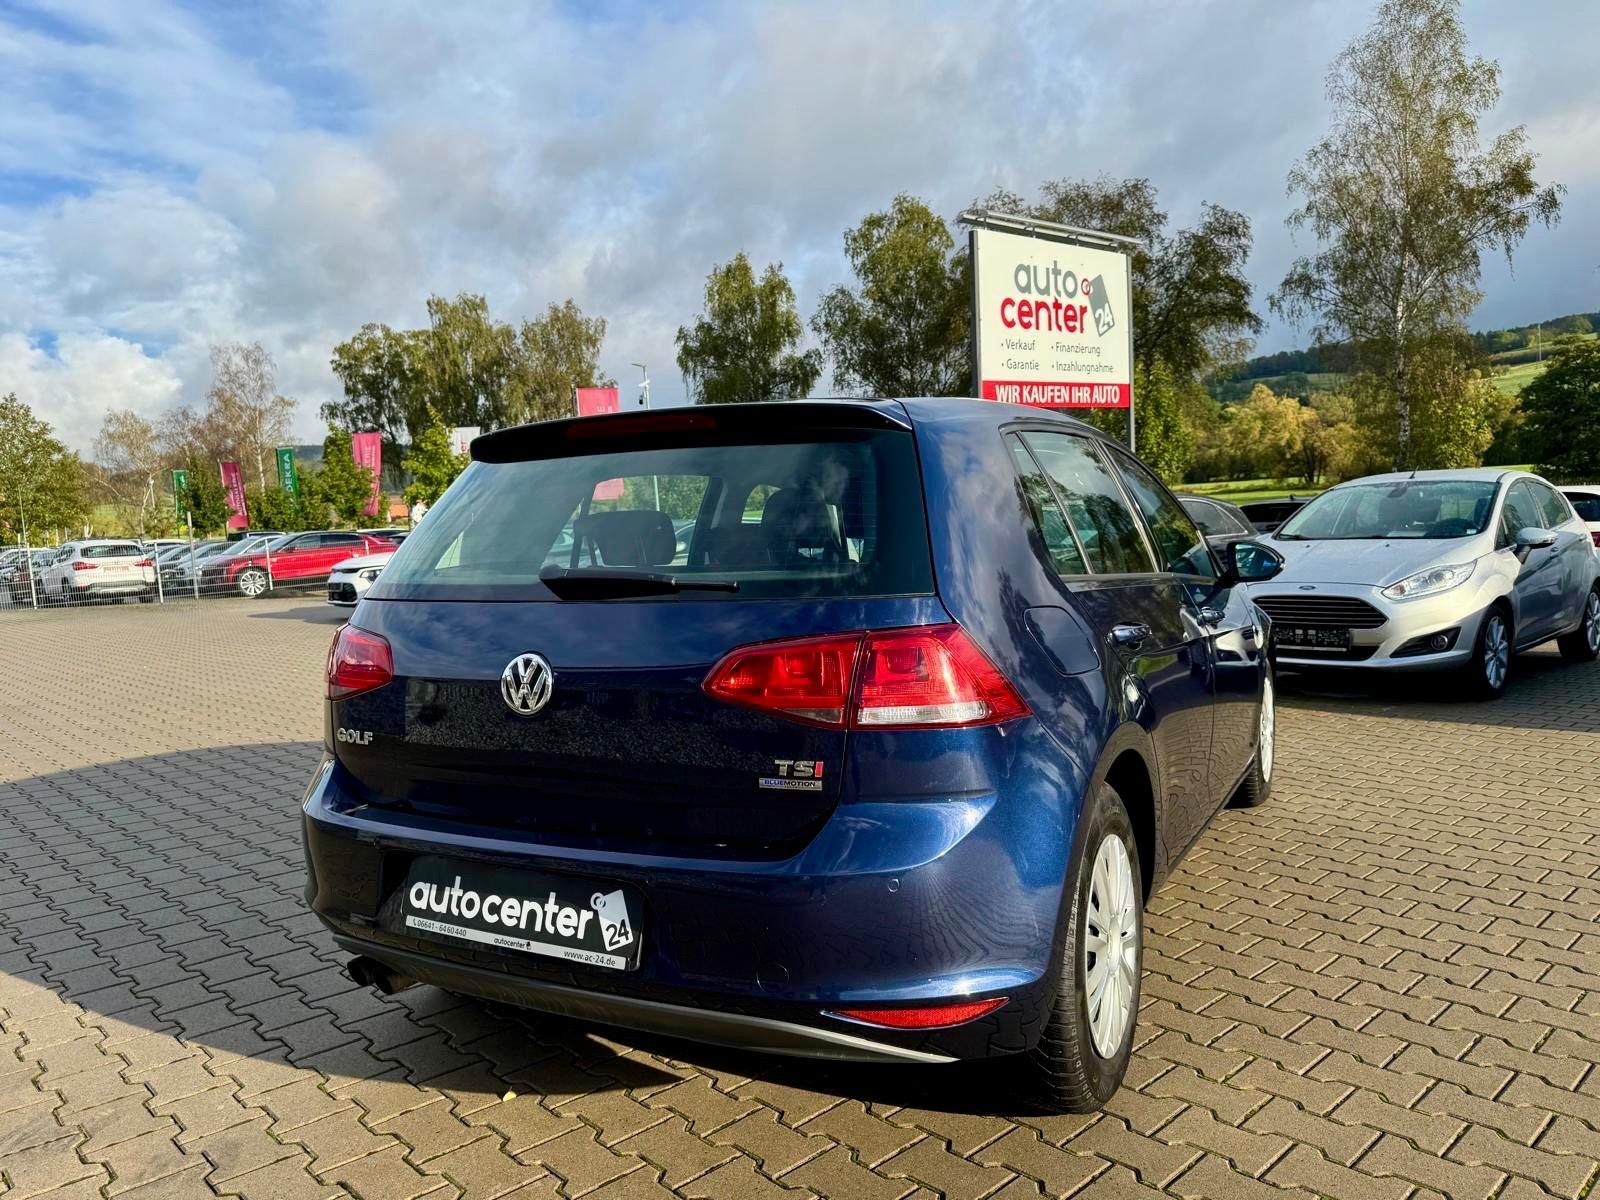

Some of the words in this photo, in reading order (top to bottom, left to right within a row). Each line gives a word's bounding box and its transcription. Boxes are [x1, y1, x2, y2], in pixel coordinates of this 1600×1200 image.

[1014, 260, 1078, 299] auto
[1000, 296, 1088, 334] center
[1094, 302, 1115, 332] 24
[1005, 339, 1036, 351] Verkauf
[1055, 341, 1101, 357] Finanzierung
[1006, 358, 1040, 371] Garantie
[1055, 361, 1114, 375] Inzahlungnahme
[995, 384, 1021, 403] WIR
[1022, 384, 1070, 403] KAUFEN
[1071, 385, 1091, 403] IHR
[1092, 385, 1120, 404] AUTO
[283, 453, 294, 493] DEKRA
[336, 727, 373, 746] GOLF
[774, 759, 824, 778] TSI
[763, 779, 816, 787] BLUEMOTION
[409, 875, 594, 940] autocenter
[604, 919, 630, 947] 24
[494, 937, 526, 949] autocenter
[563, 950, 616, 967] www.ac-24.de
